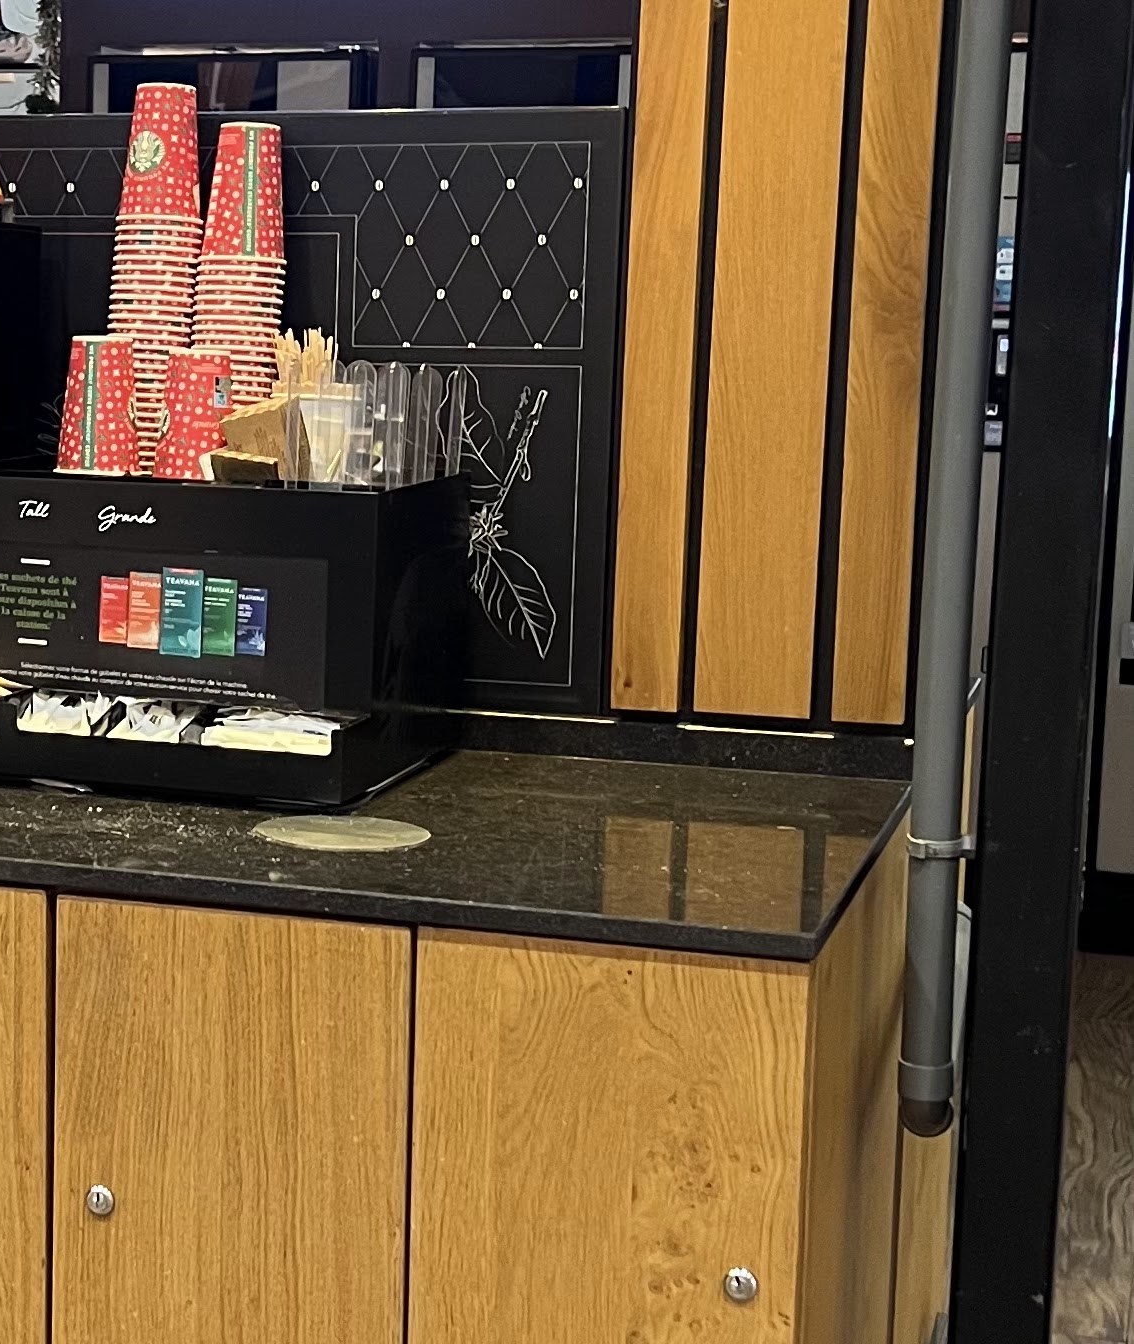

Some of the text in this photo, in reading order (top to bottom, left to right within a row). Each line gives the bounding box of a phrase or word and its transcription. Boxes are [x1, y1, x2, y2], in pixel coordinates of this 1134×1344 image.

[18, 500, 50, 519] Tall
[97, 505, 157, 532] Grande
[165, 577, 201, 587] TEAVANA
